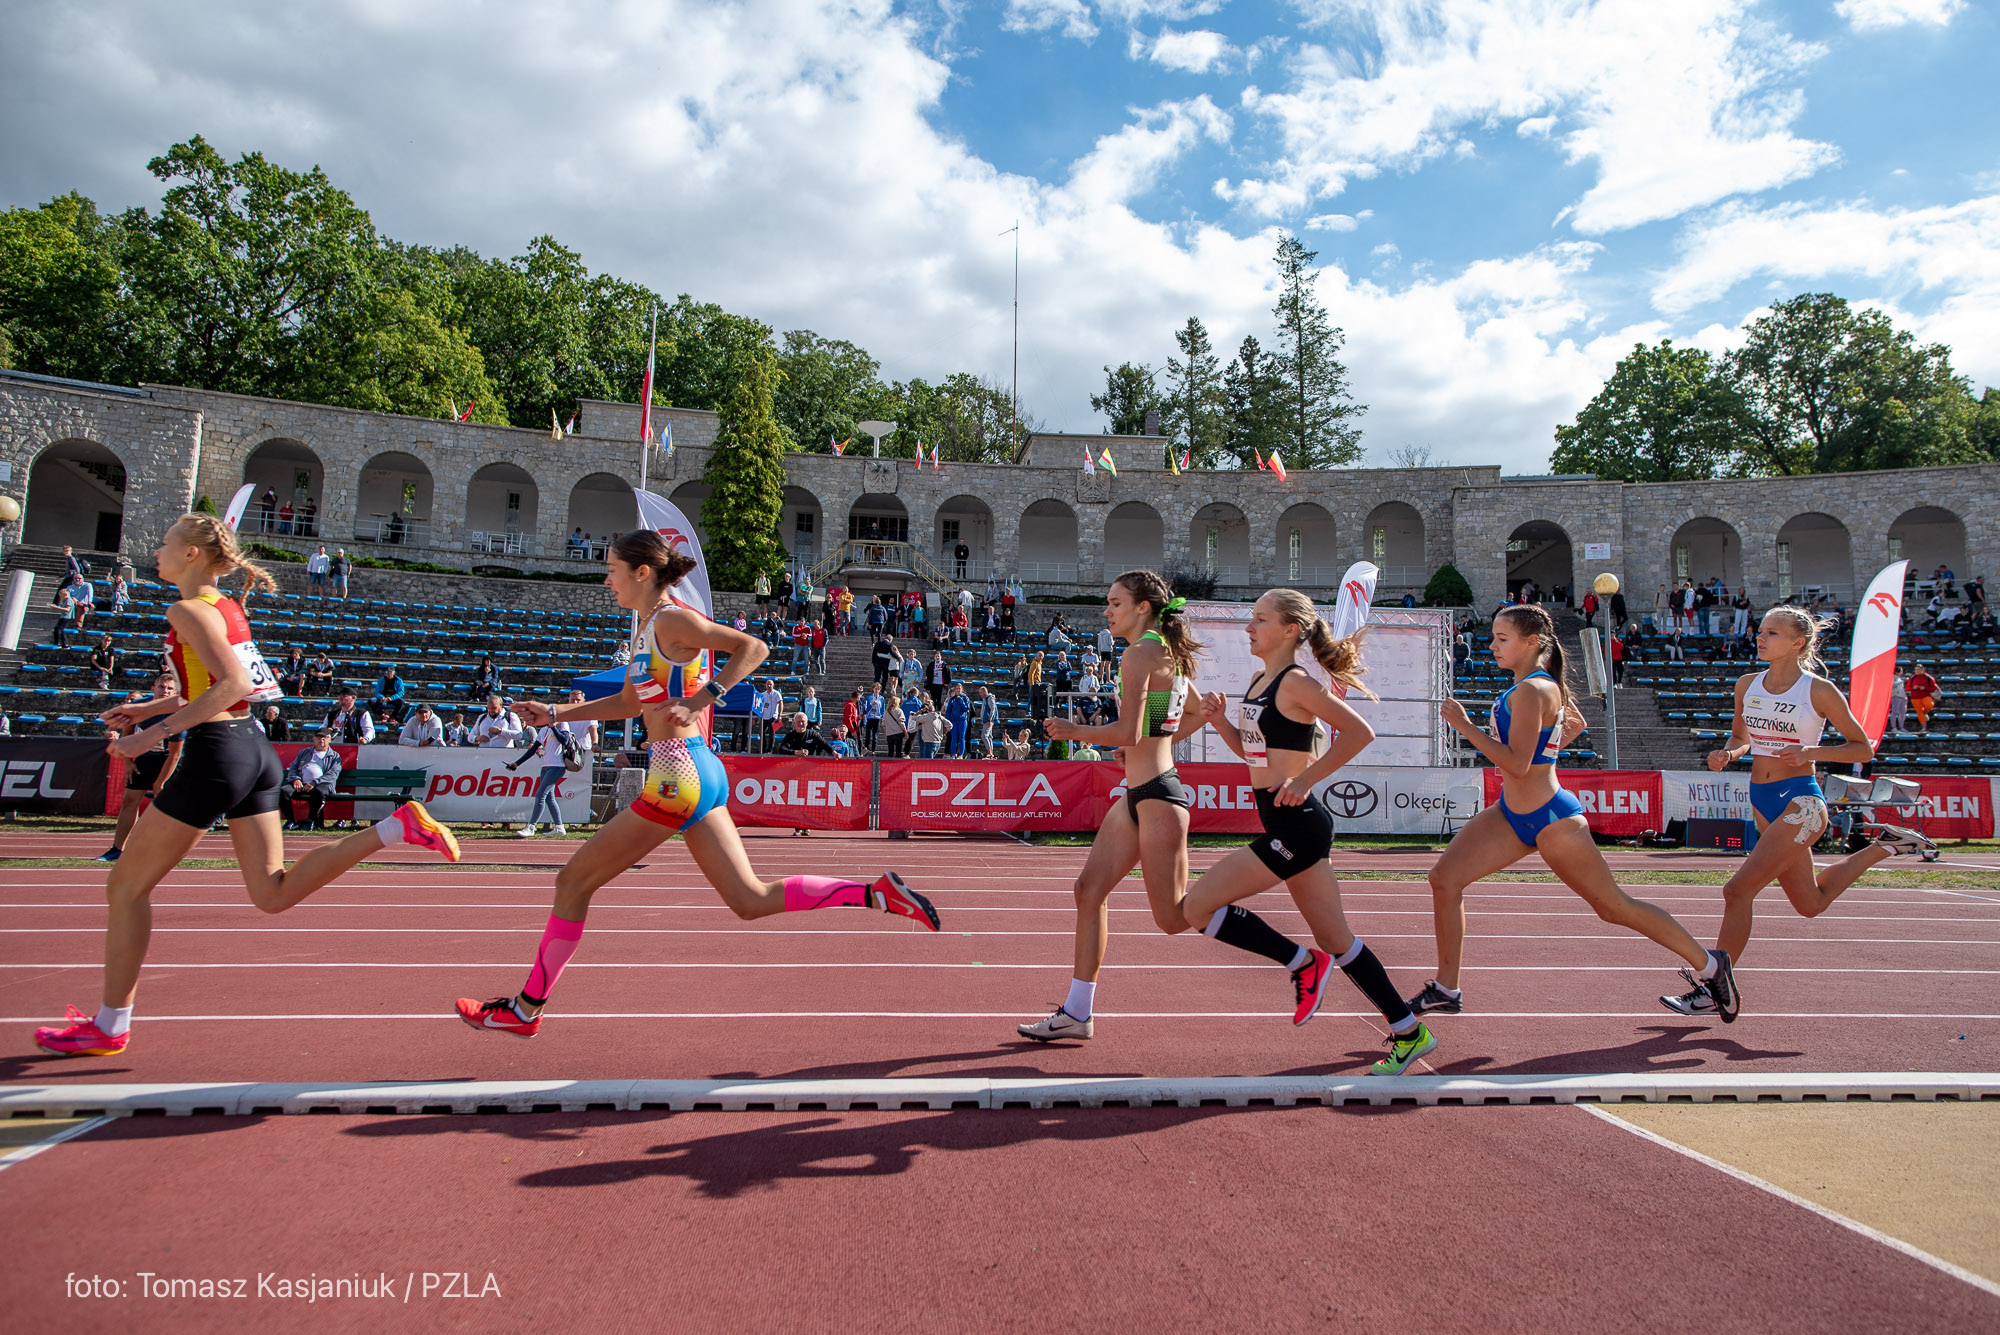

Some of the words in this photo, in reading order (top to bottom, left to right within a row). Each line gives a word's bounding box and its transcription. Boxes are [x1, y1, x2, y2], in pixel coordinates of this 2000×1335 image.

[1242, 707, 1257, 720] 762
[1773, 702, 1797, 714] 727
[1744, 715, 1797, 733] ESZCZYŃSKA
[0, 760, 76, 799] EL
[911, 771, 1062, 806] PZLA
[735, 778, 853, 807] ORLEN
[1394, 792, 1457, 813] Okęcie
[1566, 789, 1649, 814] RLEN
[1688, 782, 1731, 803] NESTLÉ
[1733, 788, 1749, 803] for
[945, 811, 986, 820] ZWIĄZEK
[1023, 811, 1062, 819] ATLETYKI
